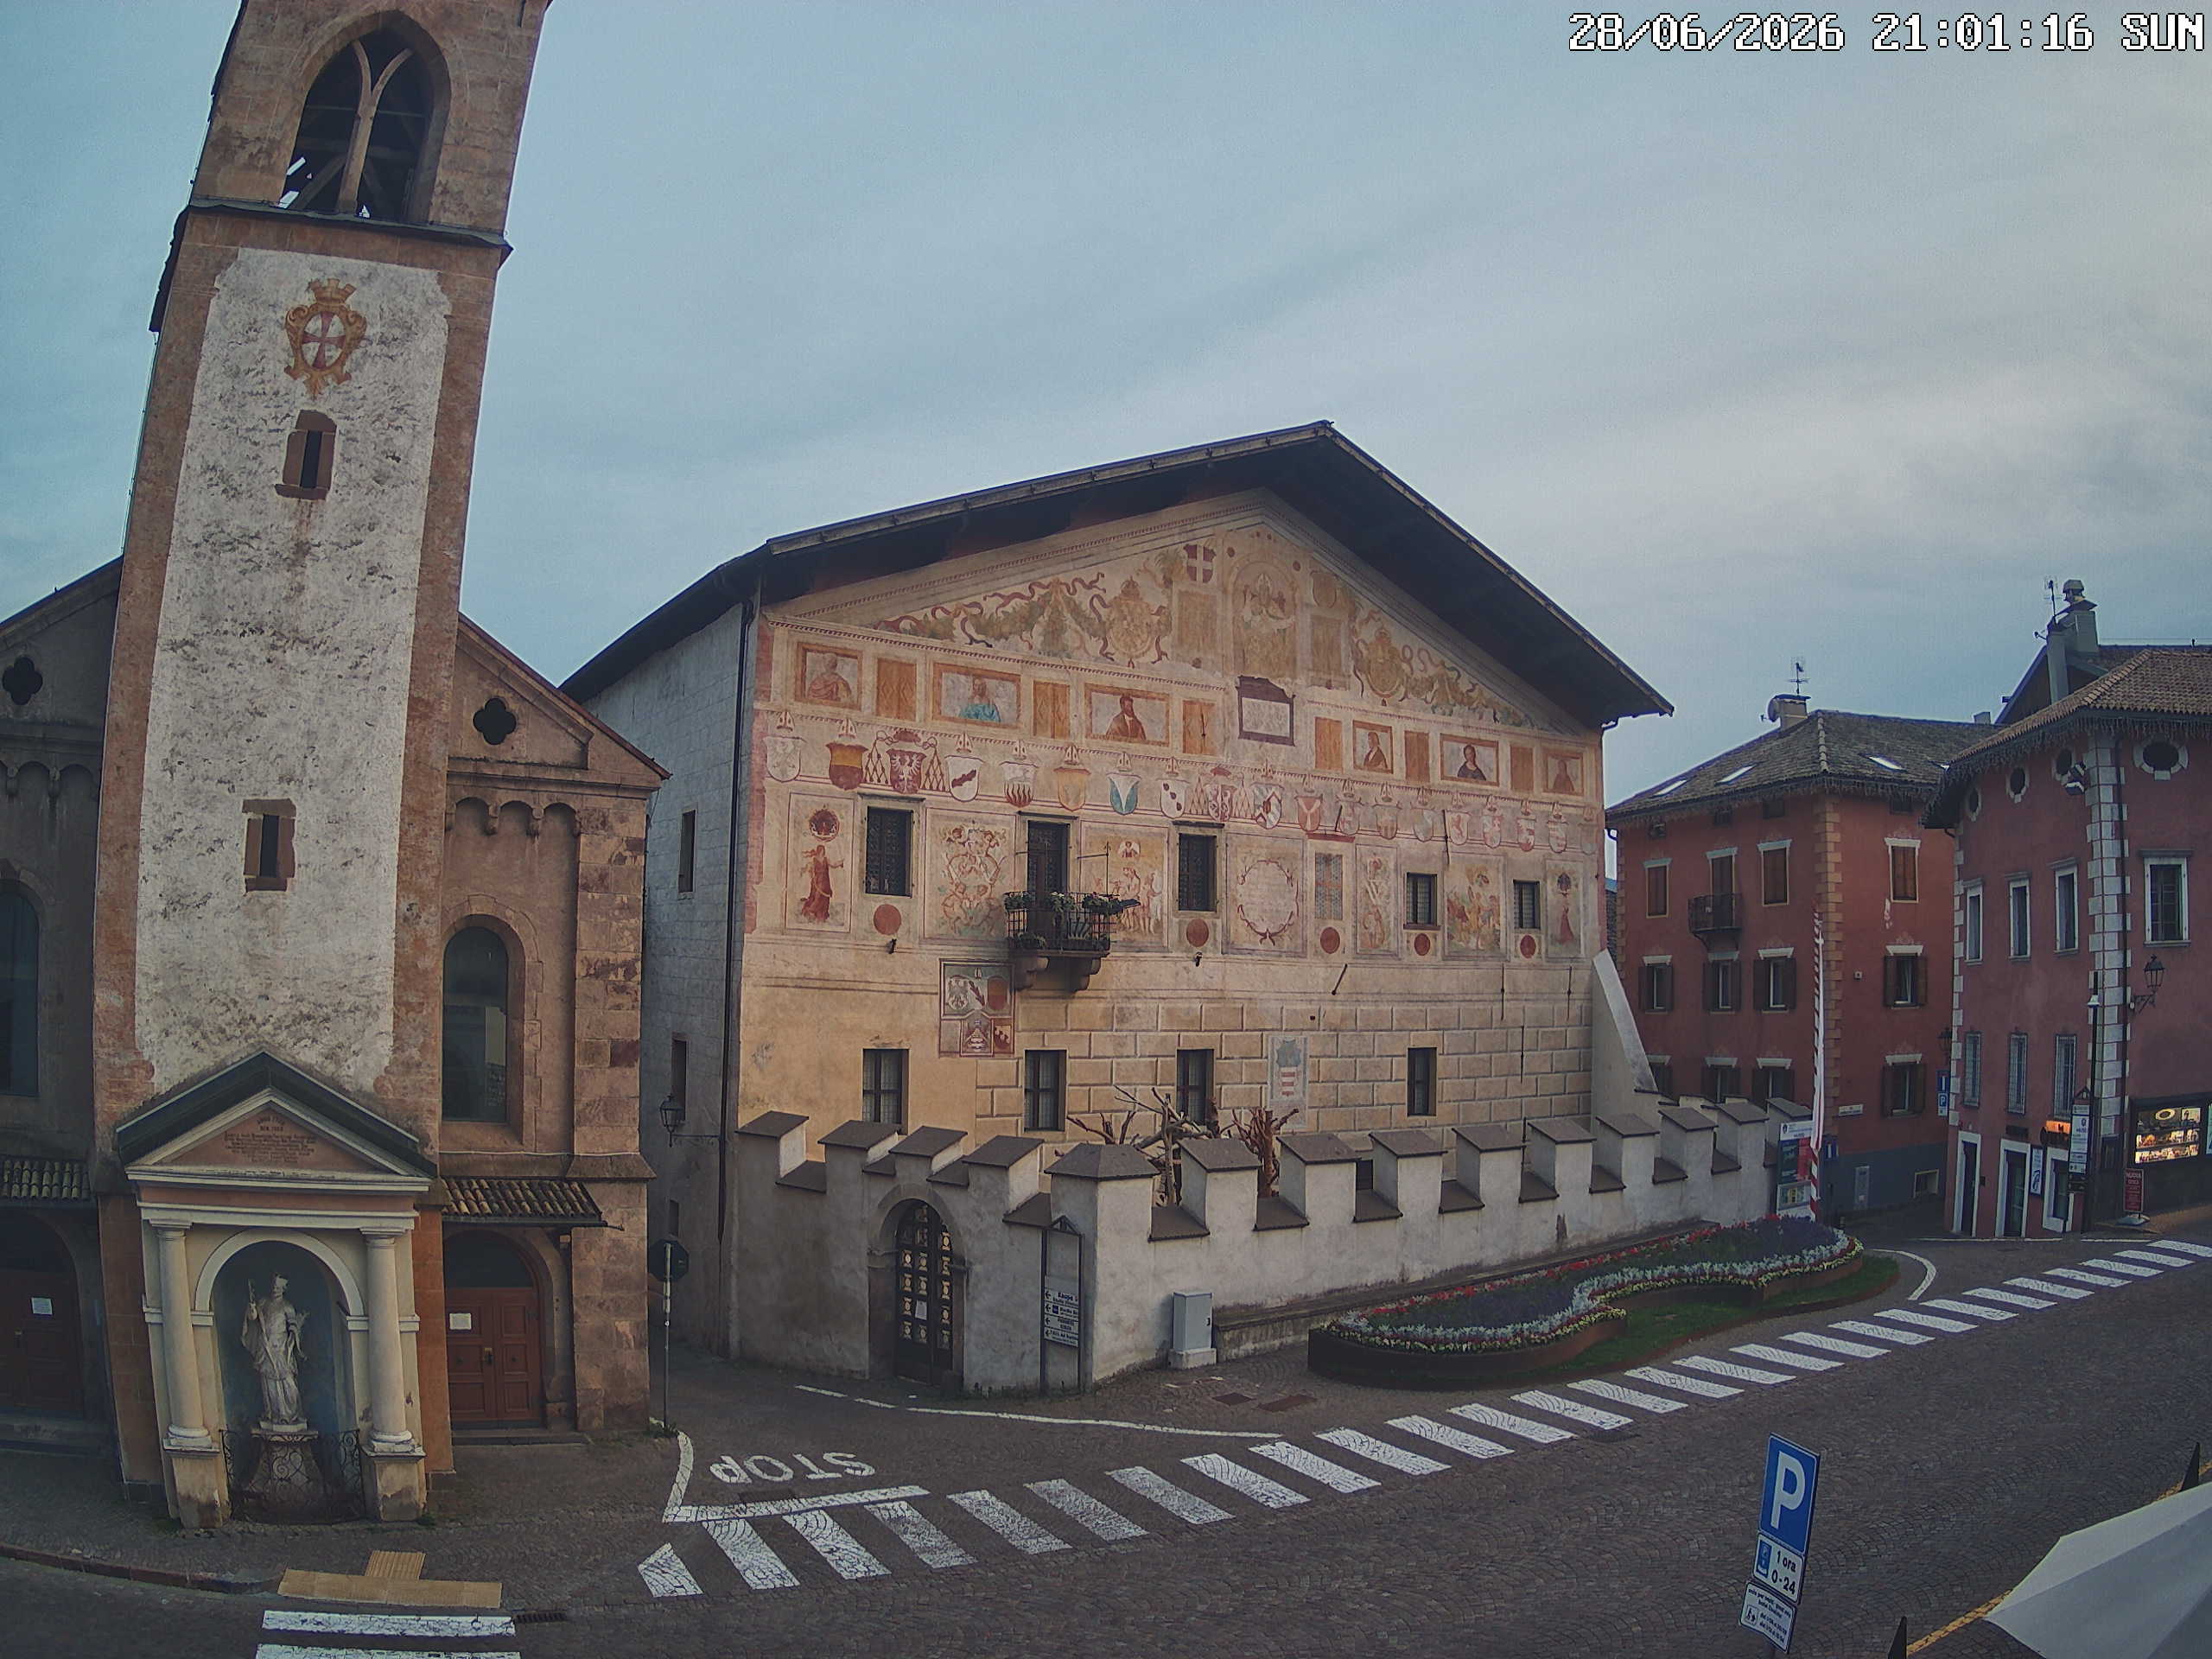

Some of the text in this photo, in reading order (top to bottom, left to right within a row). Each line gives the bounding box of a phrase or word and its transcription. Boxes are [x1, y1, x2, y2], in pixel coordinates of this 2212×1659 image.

[709, 1452, 876, 1484] STOP
[1770, 1451, 1805, 1530] P
[1777, 1550, 1796, 1573] 1 ora
[1771, 1569, 1796, 1595] 0-24
